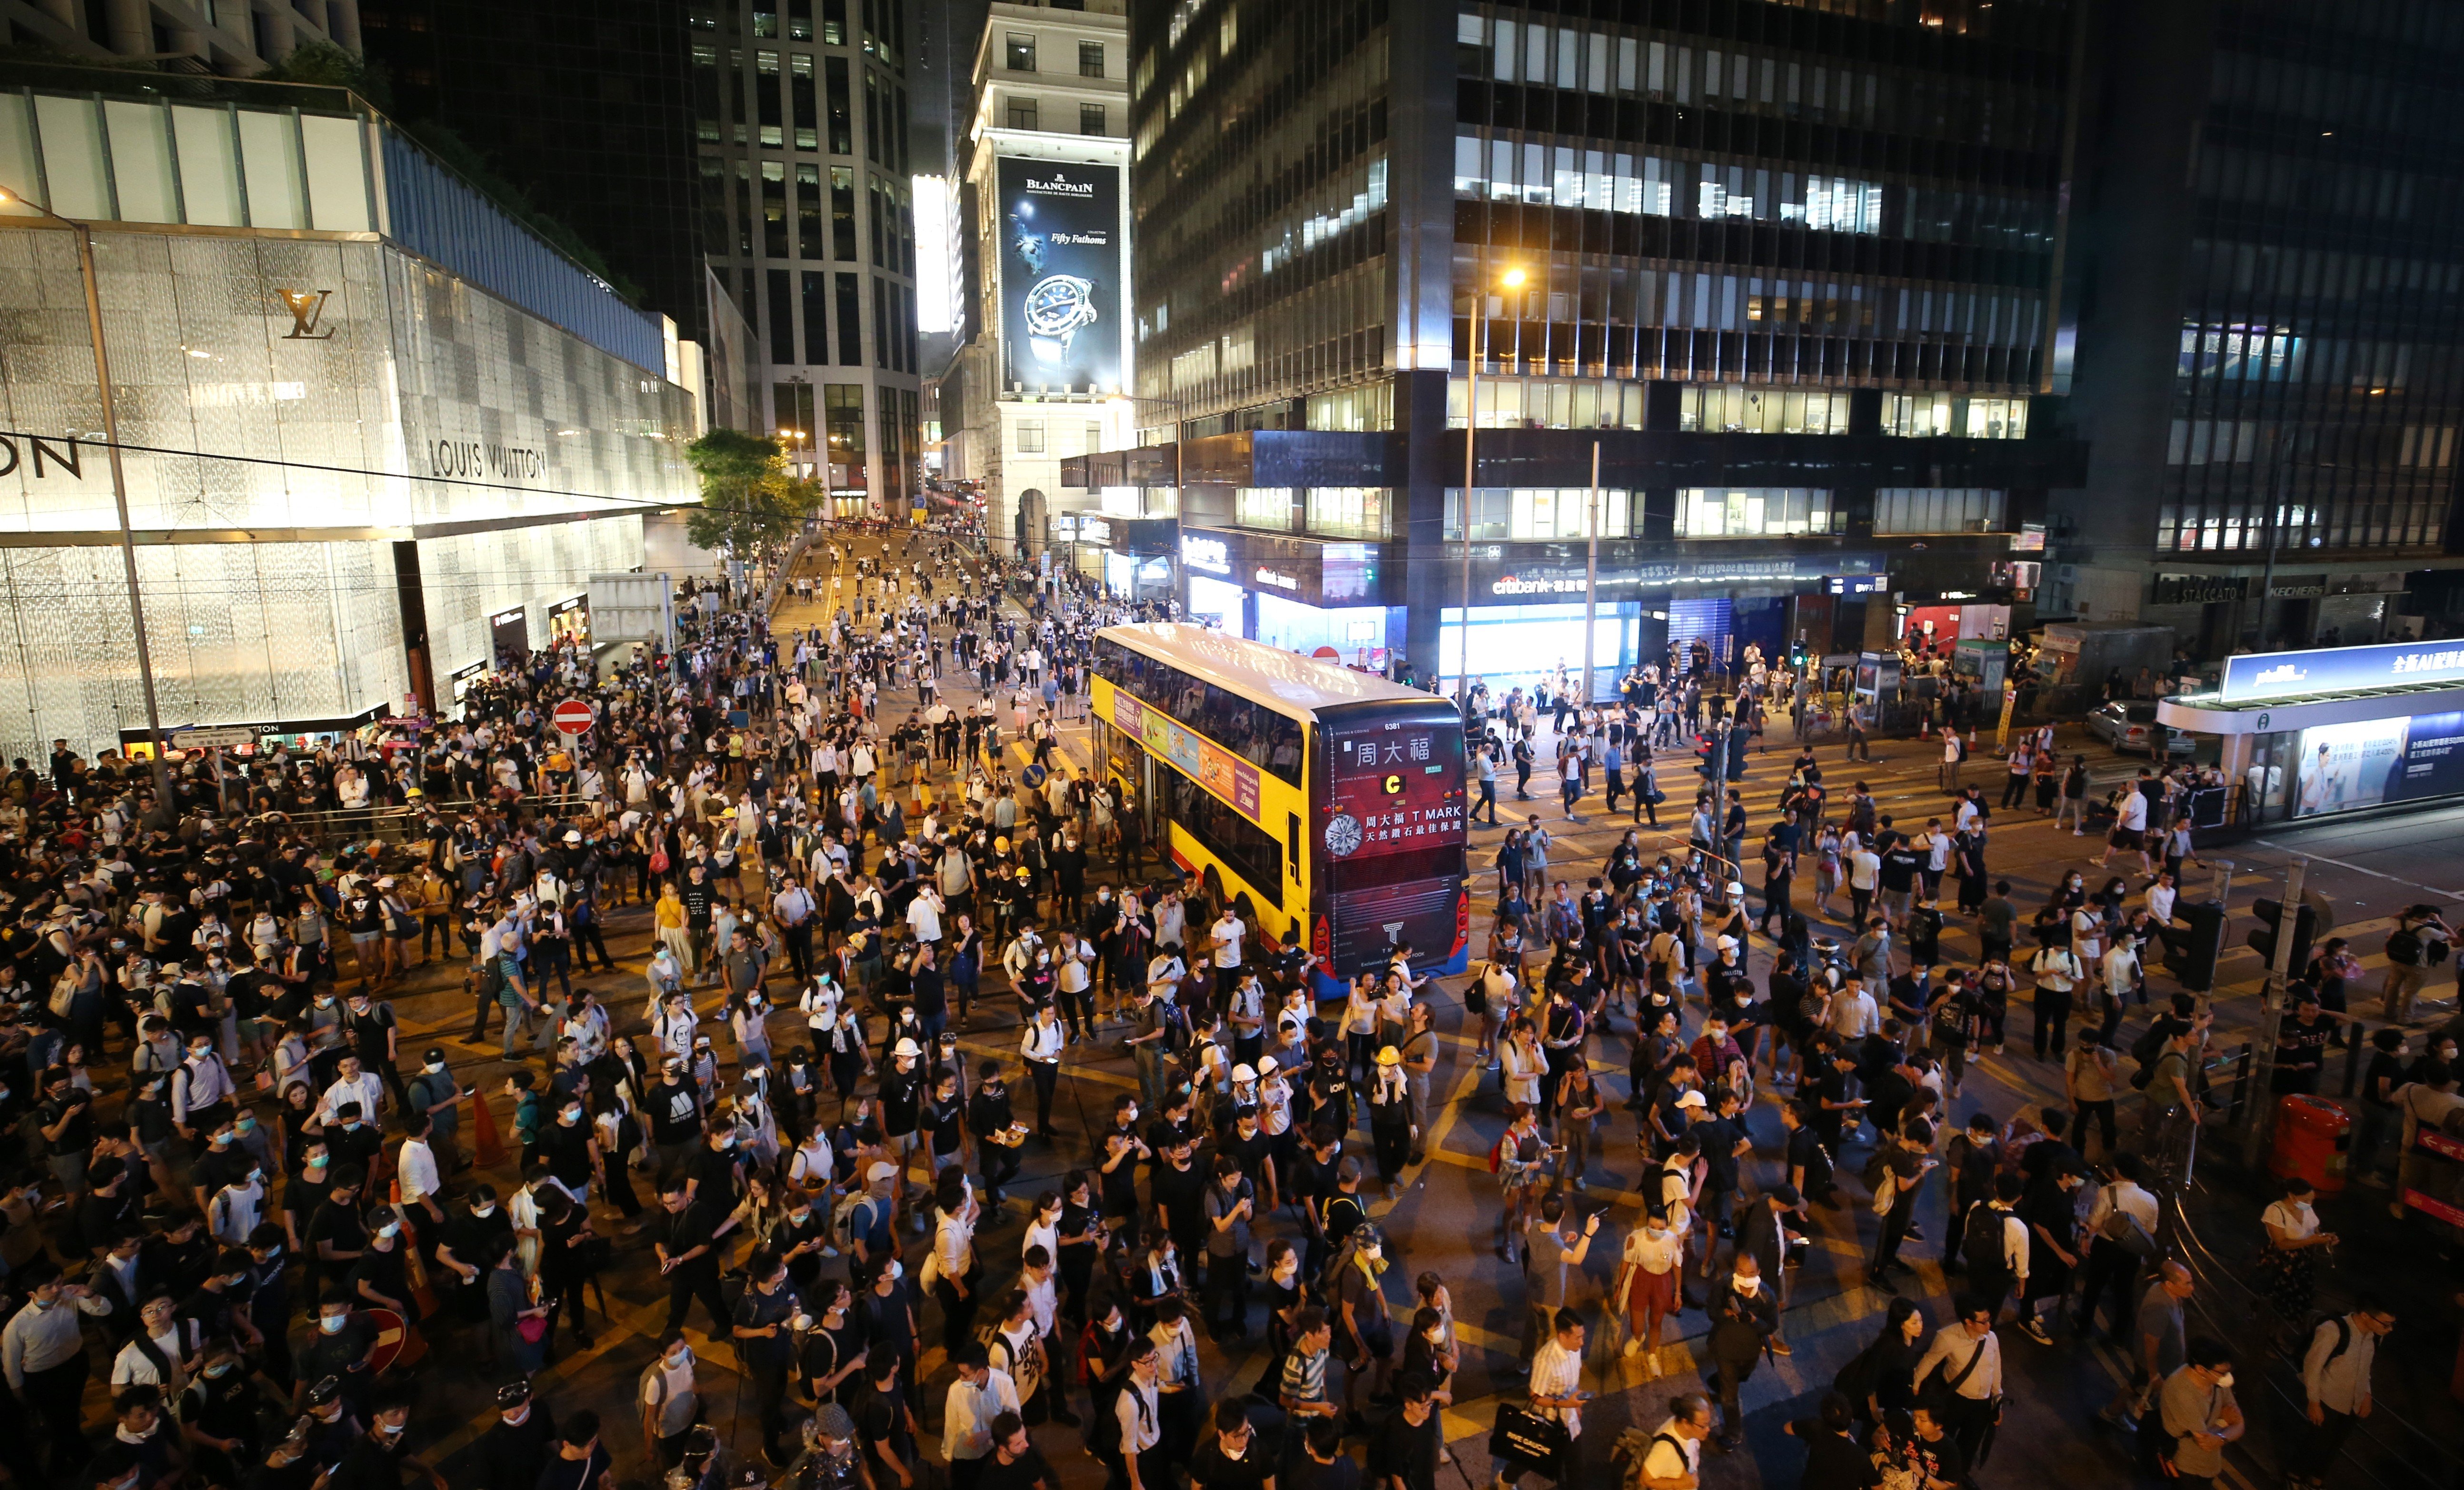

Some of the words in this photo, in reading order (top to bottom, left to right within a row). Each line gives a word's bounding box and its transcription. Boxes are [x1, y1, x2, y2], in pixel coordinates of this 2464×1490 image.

[1051, 233, 1071, 245] Fifty
[1071, 234, 1106, 245] Fathoms
[429, 439, 482, 477] LOUIS
[487, 443, 546, 480] VUITTON
[1492, 576, 1549, 595] citibank
[2270, 586, 2325, 597] KECHERS
[2181, 586, 2237, 603] STACCATO
[1384, 723, 1401, 731] 6381
[1357, 737, 1430, 767] 周大福
[1365, 812, 1404, 829] 周大福
[1412, 811, 1420, 822] T
[1426, 805, 1461, 821] MARK
[1365, 820, 1461, 843] 天然鑽石最佳保證
